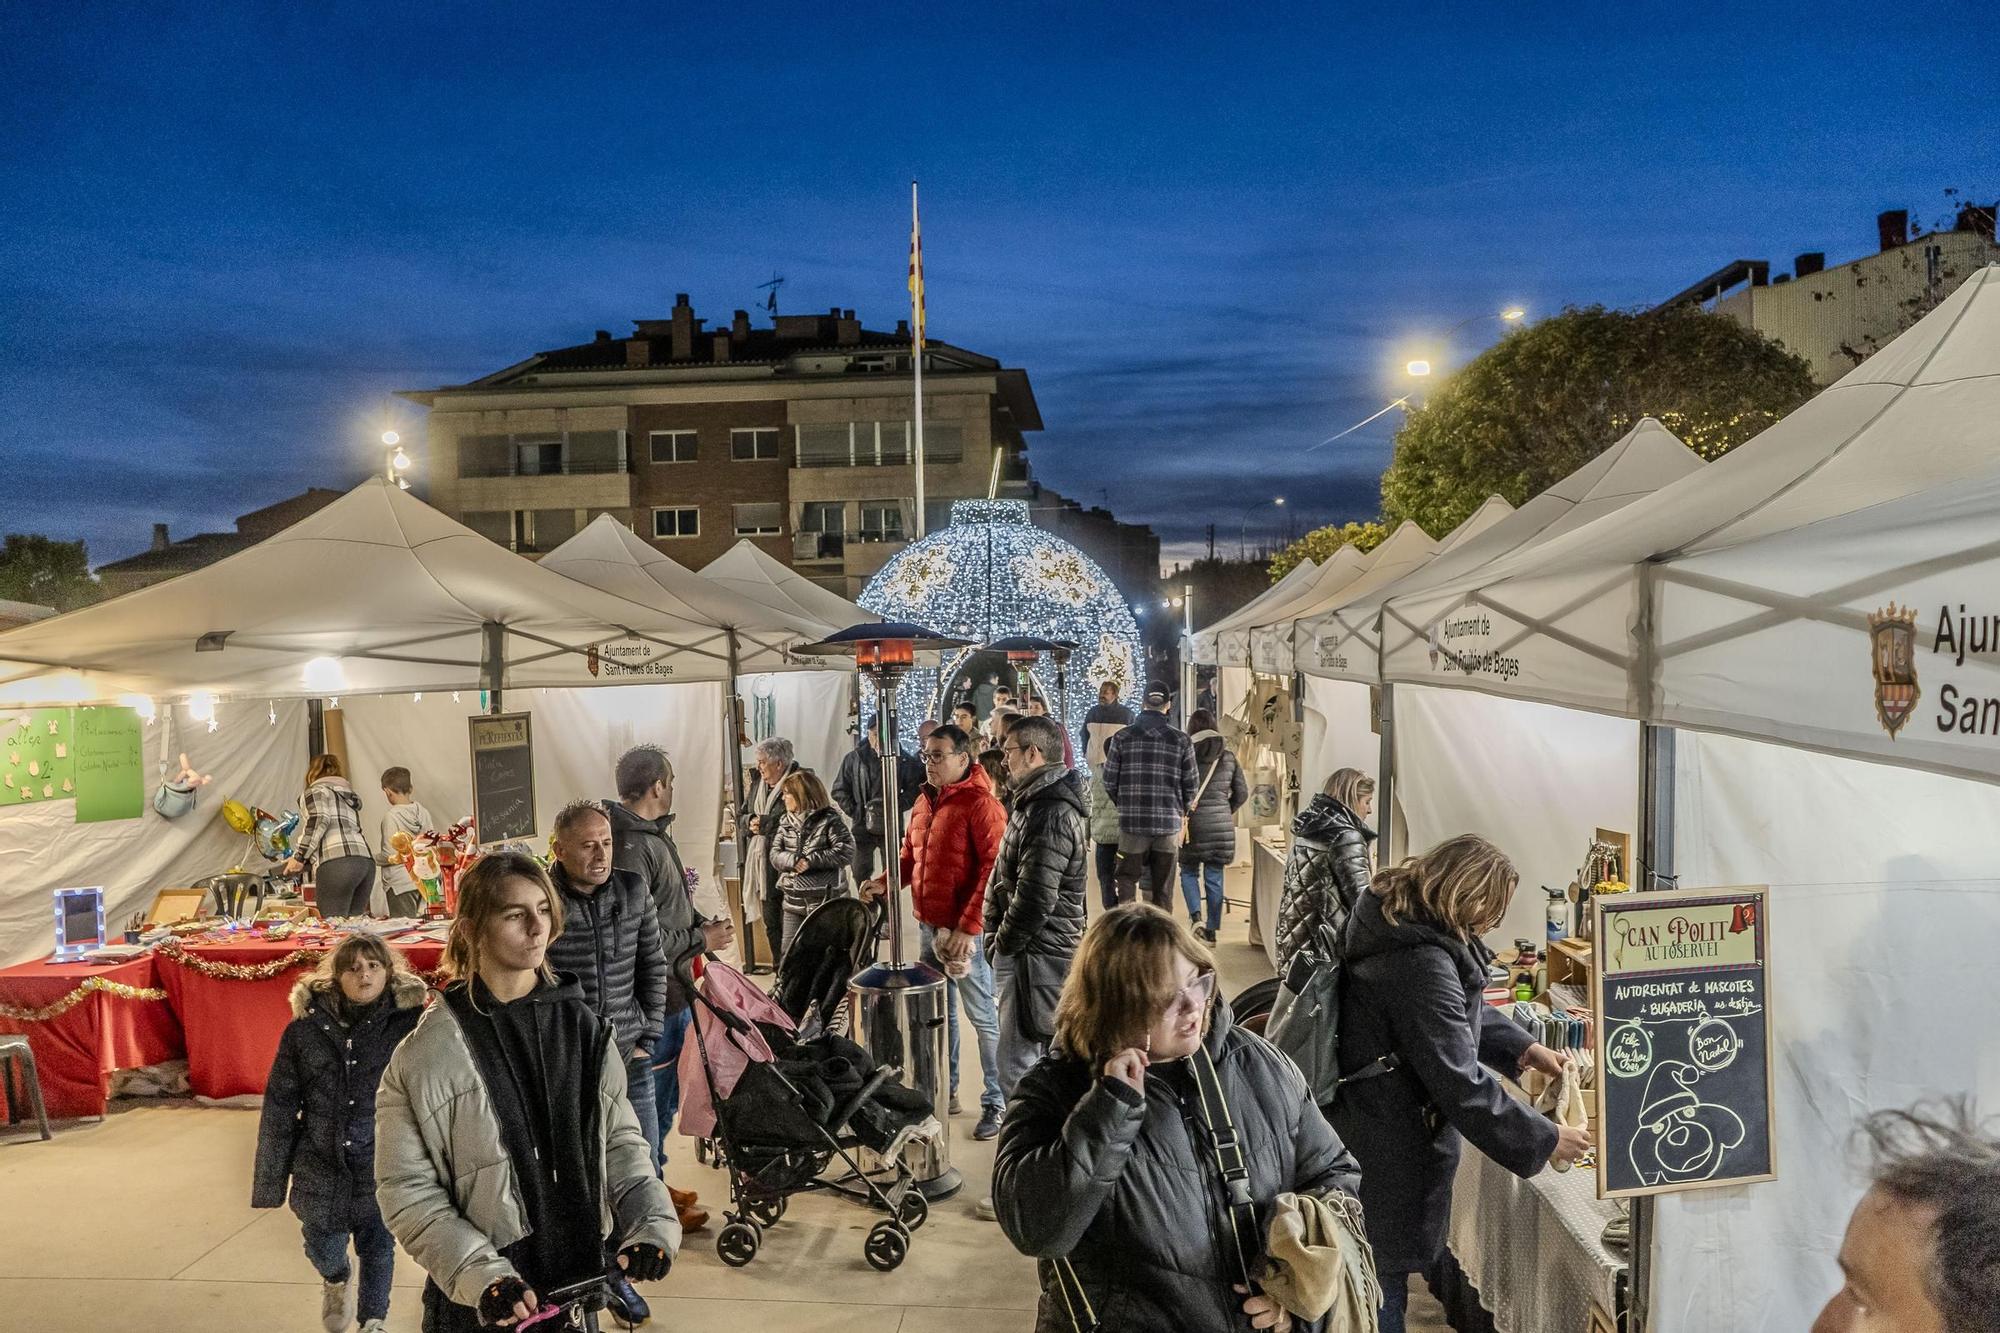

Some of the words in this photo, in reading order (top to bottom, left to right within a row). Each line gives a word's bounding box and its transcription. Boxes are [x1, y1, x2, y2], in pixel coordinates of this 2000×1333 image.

[1443, 615, 1480, 644] Ajuntament
[1481, 613, 1490, 636] de
[604, 645, 642, 659] Ajuntament
[643, 645, 651, 656] de
[604, 663, 621, 676] Sant
[646, 663, 653, 674] de
[655, 662, 674, 677] Bages
[1483, 650, 1493, 673] de
[1494, 651, 1519, 681] Bages
[1627, 925, 1660, 947] CAN
[1645, 942, 1719, 962] AUTOSERVEI
[1615, 982, 1685, 1000] AUTORENTAT
[1704, 979, 1755, 995] MASCOTES
[1695, 1034, 1724, 1051] Bon
[1698, 1038, 1735, 1063] Nadal
